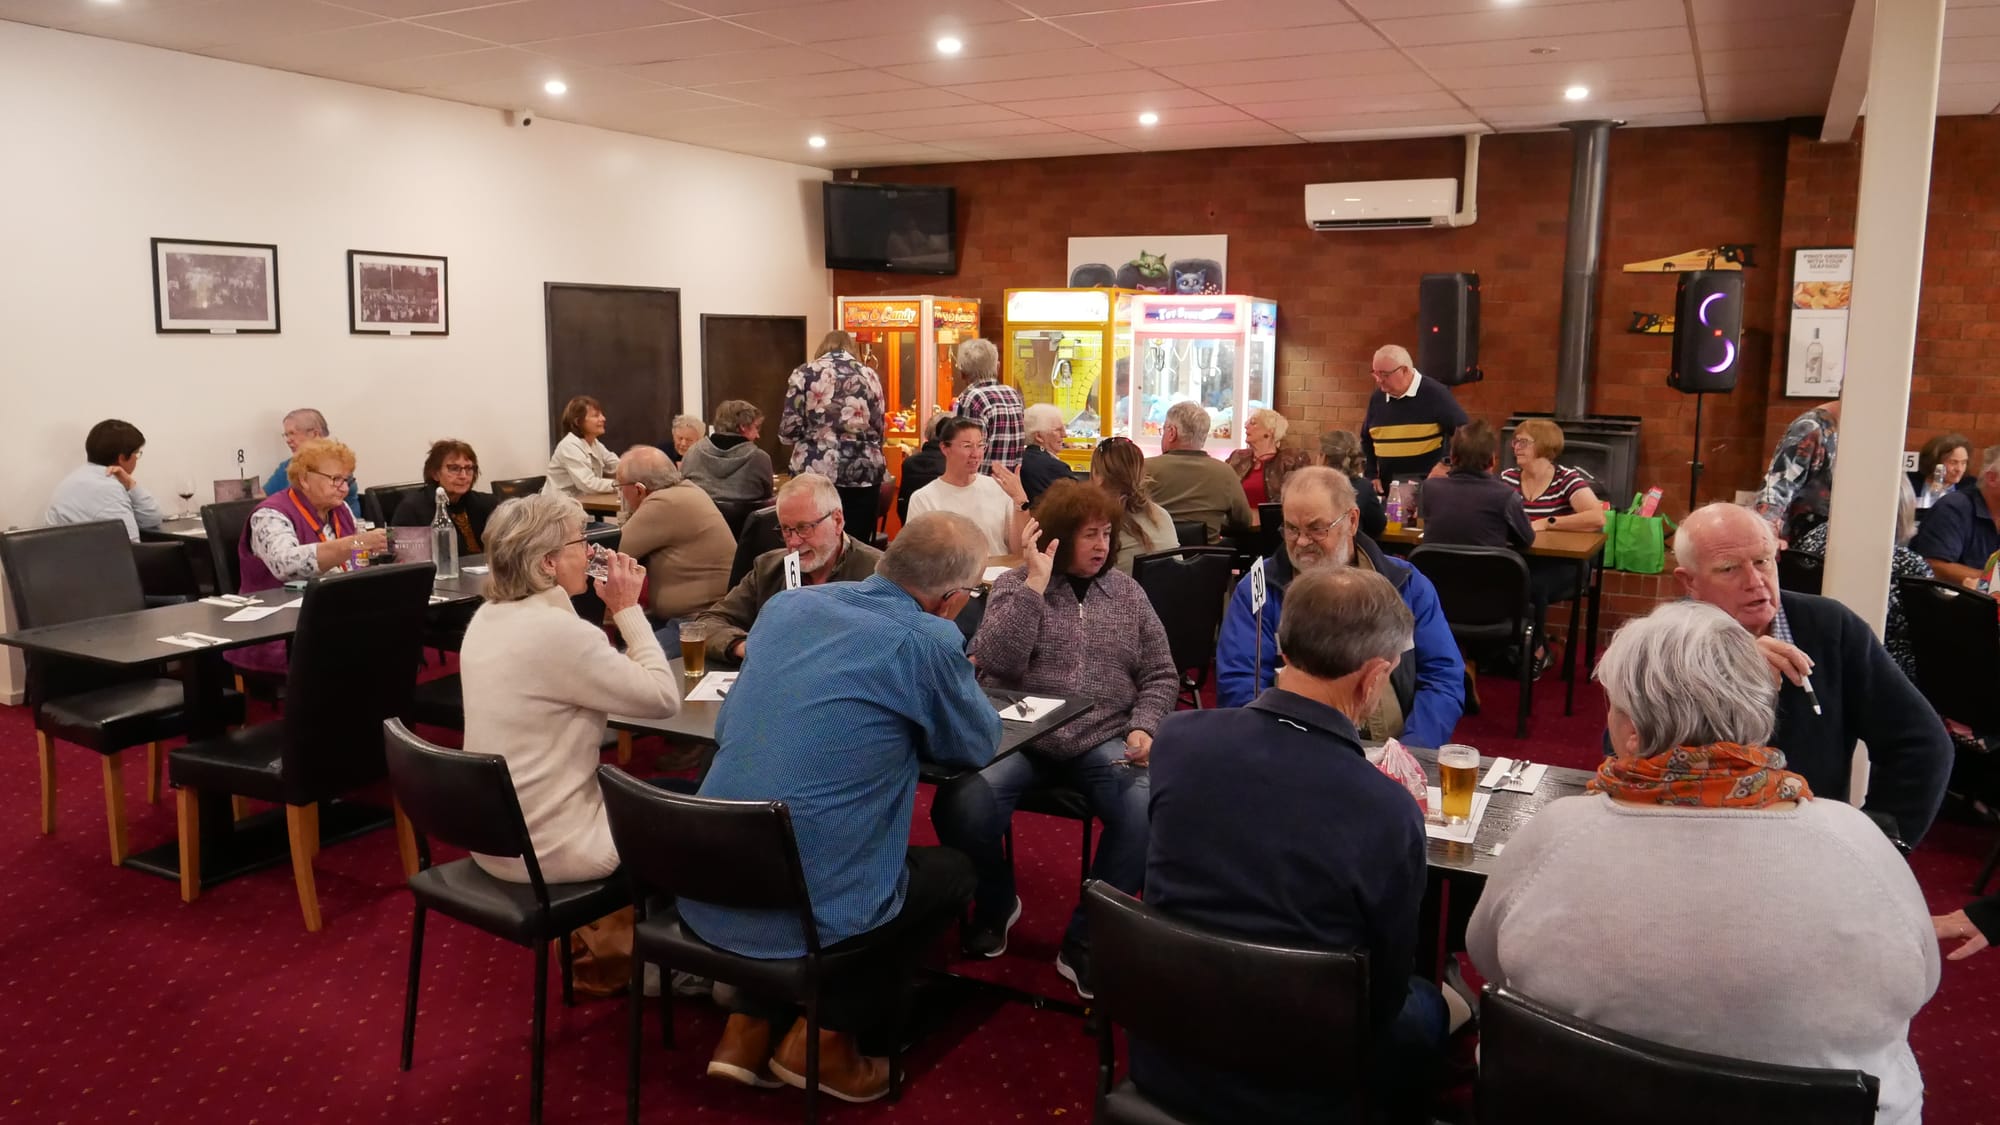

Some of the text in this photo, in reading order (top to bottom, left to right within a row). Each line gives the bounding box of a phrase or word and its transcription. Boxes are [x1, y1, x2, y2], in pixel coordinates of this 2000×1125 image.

[237, 448, 244, 463] 8
[790, 560, 797, 588] 6
[1253, 566, 1264, 602] 30
